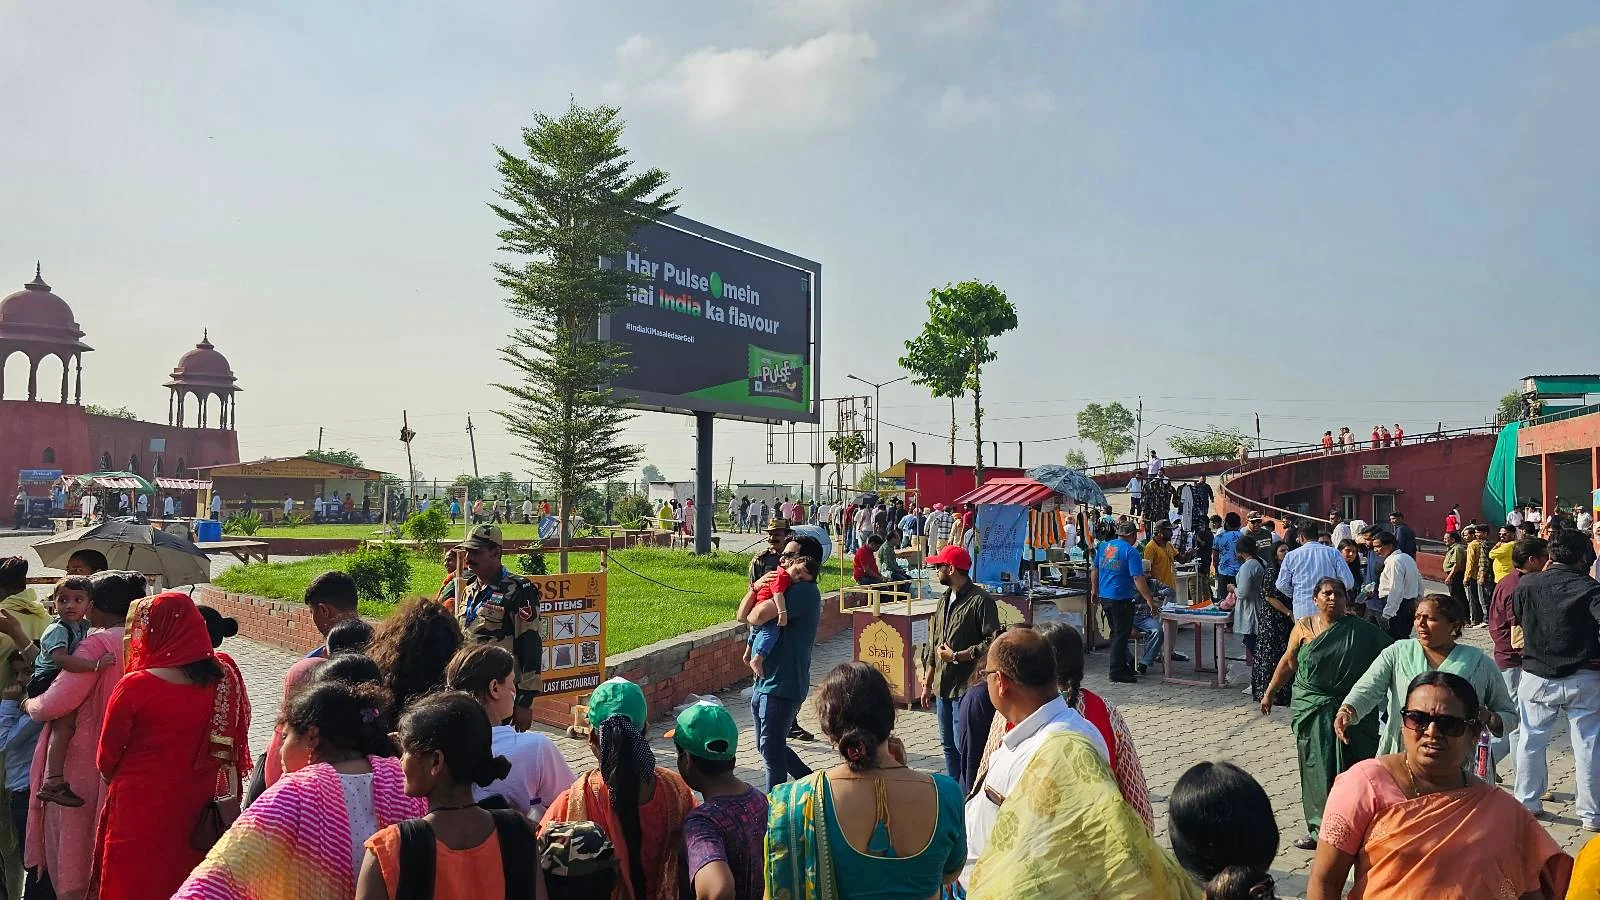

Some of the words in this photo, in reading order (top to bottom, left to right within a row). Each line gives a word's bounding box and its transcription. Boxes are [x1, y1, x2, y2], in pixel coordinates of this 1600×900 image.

[626, 250, 660, 278] Har
[663, 261, 709, 292] Pulse
[723, 281, 760, 306] mein
[658, 288, 702, 317] India
[705, 299, 725, 323] ka
[728, 305, 780, 335] flavour
[762, 360, 791, 384] PULSE
[554, 599, 583, 611] ITEMS
[868, 644, 895, 658] Shahi
[543, 680, 560, 693] LAST
[560, 675, 600, 690] RESTAURANT
